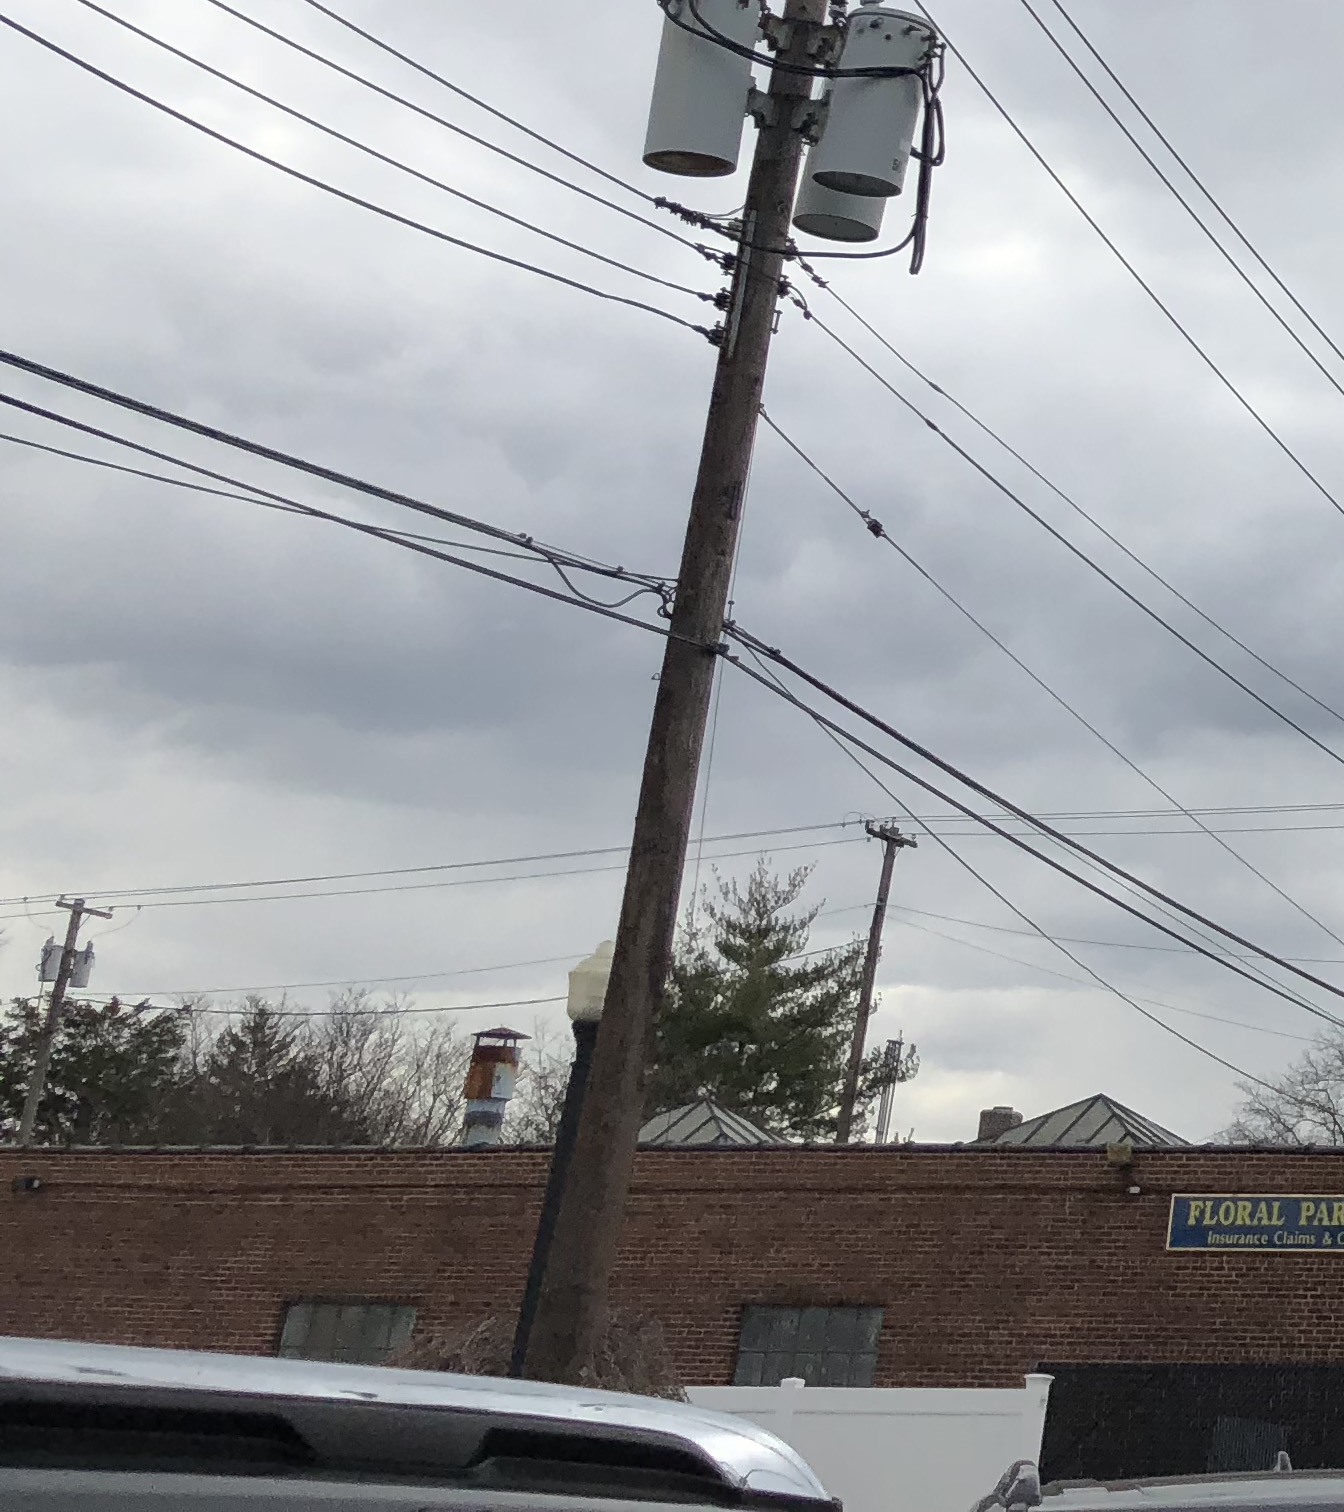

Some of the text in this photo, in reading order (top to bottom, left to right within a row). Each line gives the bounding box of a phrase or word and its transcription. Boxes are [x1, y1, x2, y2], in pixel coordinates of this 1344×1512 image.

[1187, 1200, 1284, 1226] FLORAL
[1208, 1231, 1269, 1245] Insurance
[1274, 1231, 1316, 1245] Claims
[1322, 1232, 1332, 1245] &
